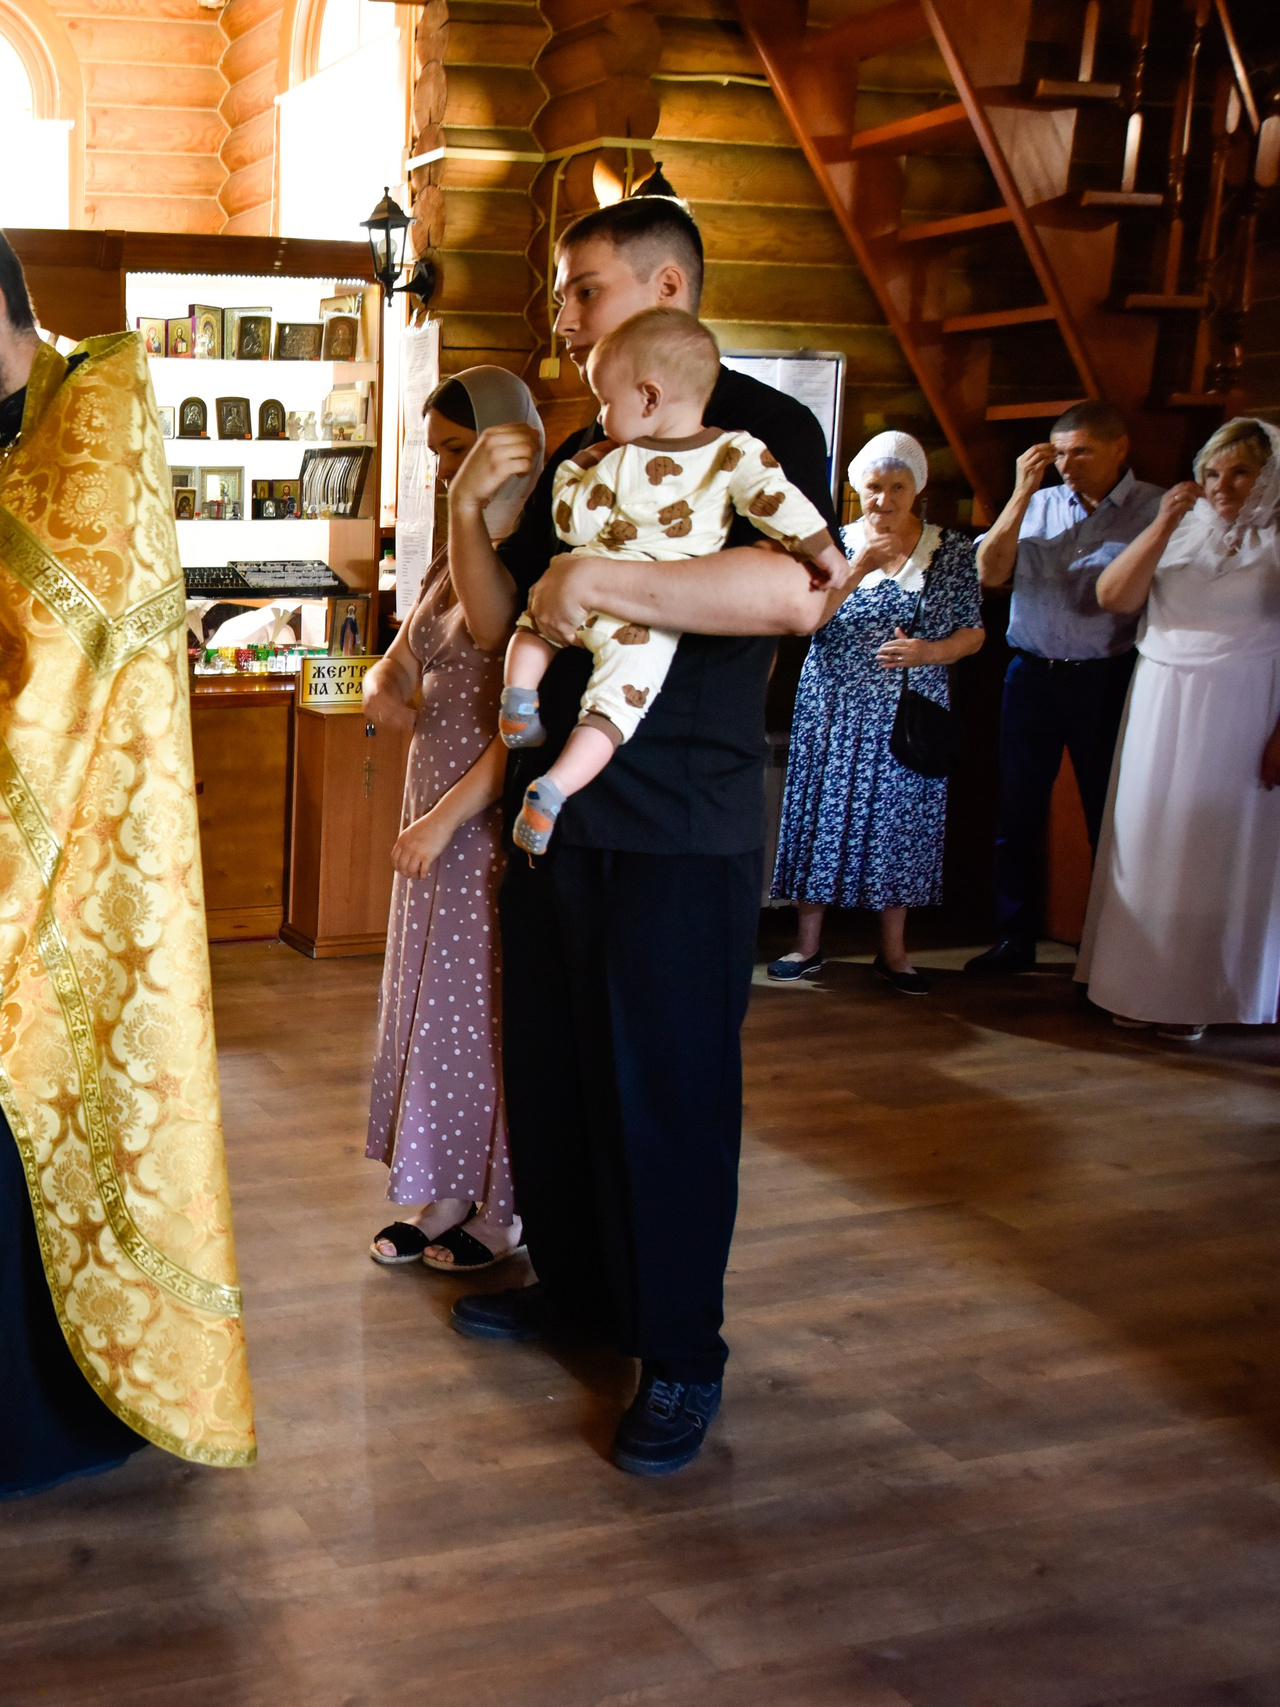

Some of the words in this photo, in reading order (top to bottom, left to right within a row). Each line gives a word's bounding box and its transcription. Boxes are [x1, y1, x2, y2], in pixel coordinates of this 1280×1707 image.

[312, 665, 370, 678] ЖЕРТВ
[308, 682, 329, 695] НА
[334, 681, 363, 695] ХРА
